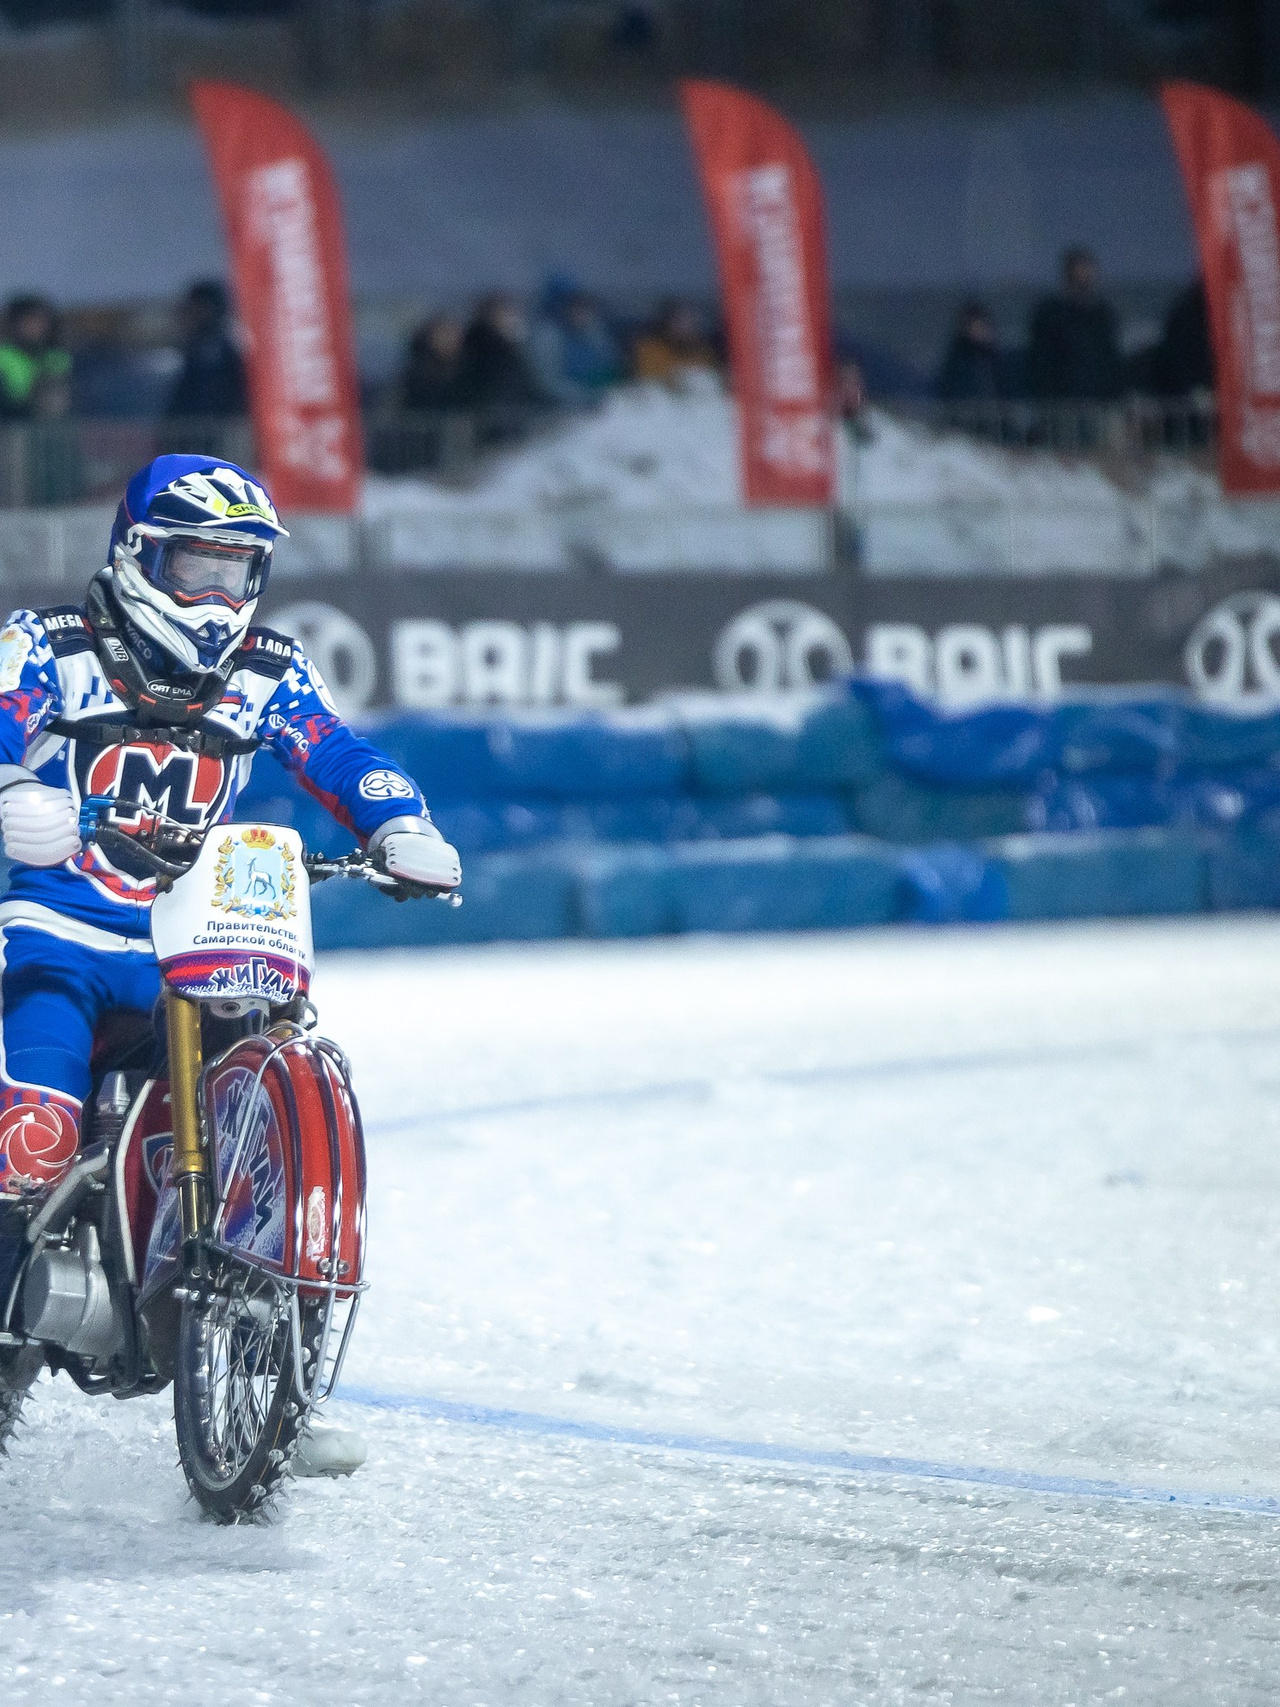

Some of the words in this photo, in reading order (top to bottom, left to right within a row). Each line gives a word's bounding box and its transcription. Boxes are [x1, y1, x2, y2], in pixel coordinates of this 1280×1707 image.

[44, 614, 85, 631] MEGA
[256, 635, 292, 657] LADA
[390, 617, 620, 706] BAIC
[193, 934, 266, 946] Самарской
